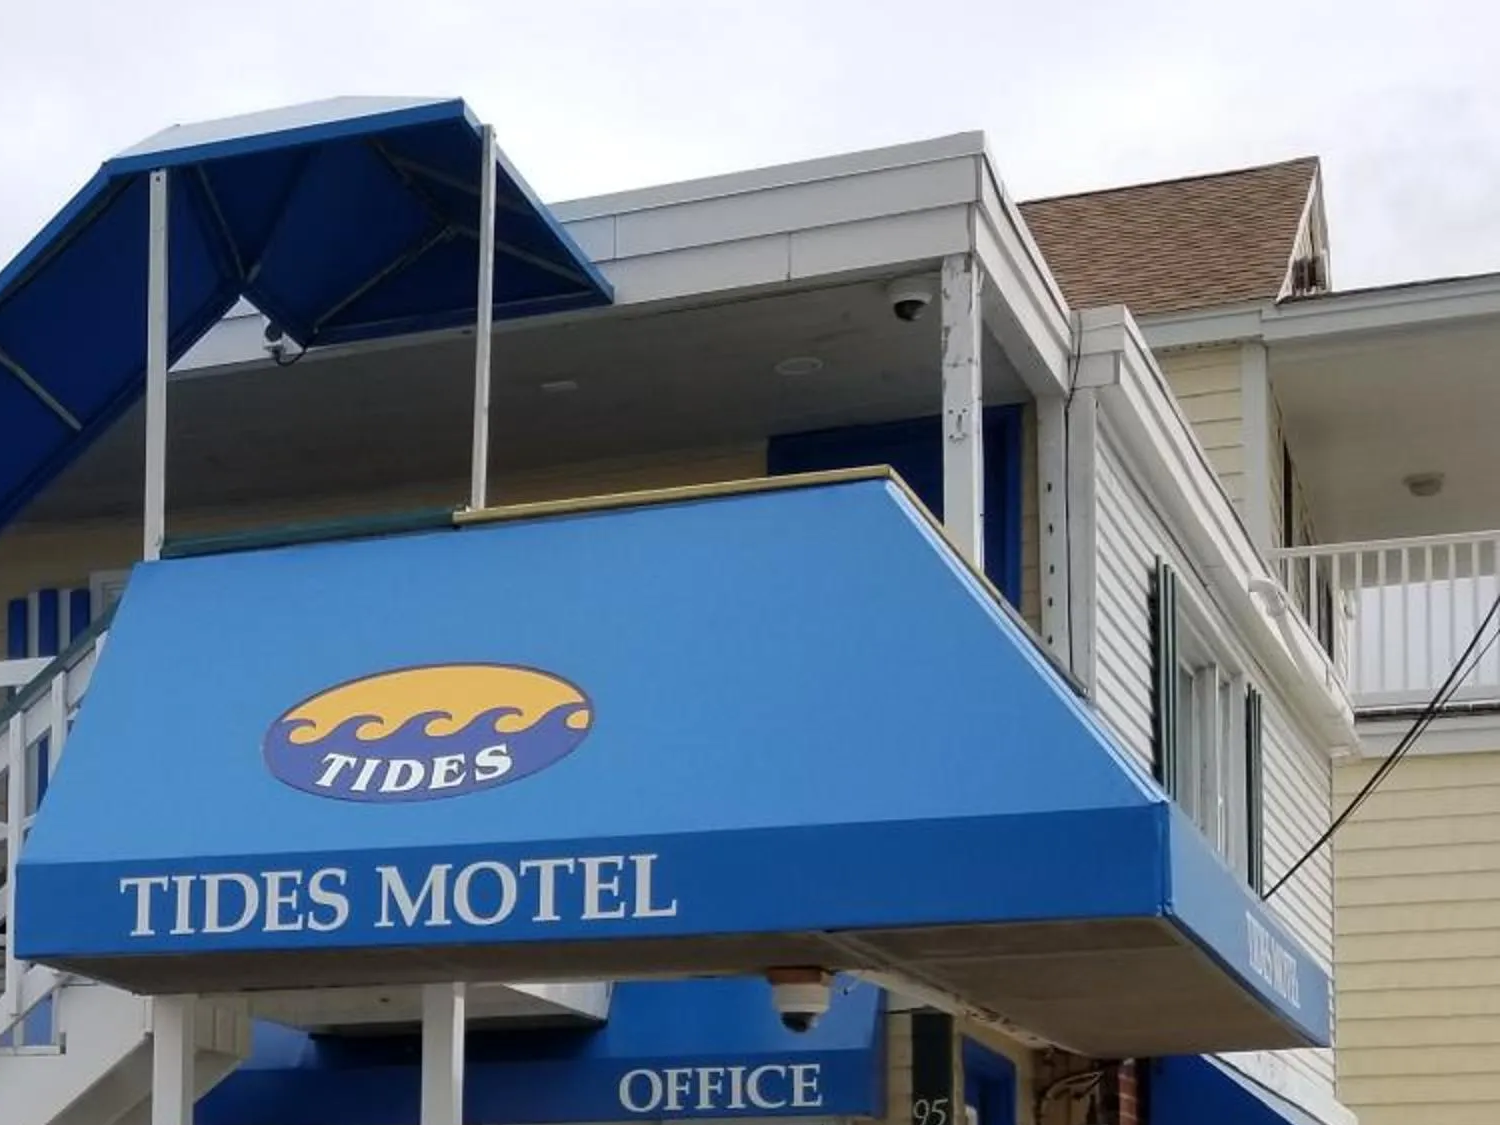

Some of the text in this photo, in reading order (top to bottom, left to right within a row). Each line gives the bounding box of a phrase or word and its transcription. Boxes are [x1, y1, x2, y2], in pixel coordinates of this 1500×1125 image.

[315, 743, 514, 794] TIDES
[119, 853, 677, 937] TIDES MOTEL
[618, 1063, 823, 1113] OFFICE
